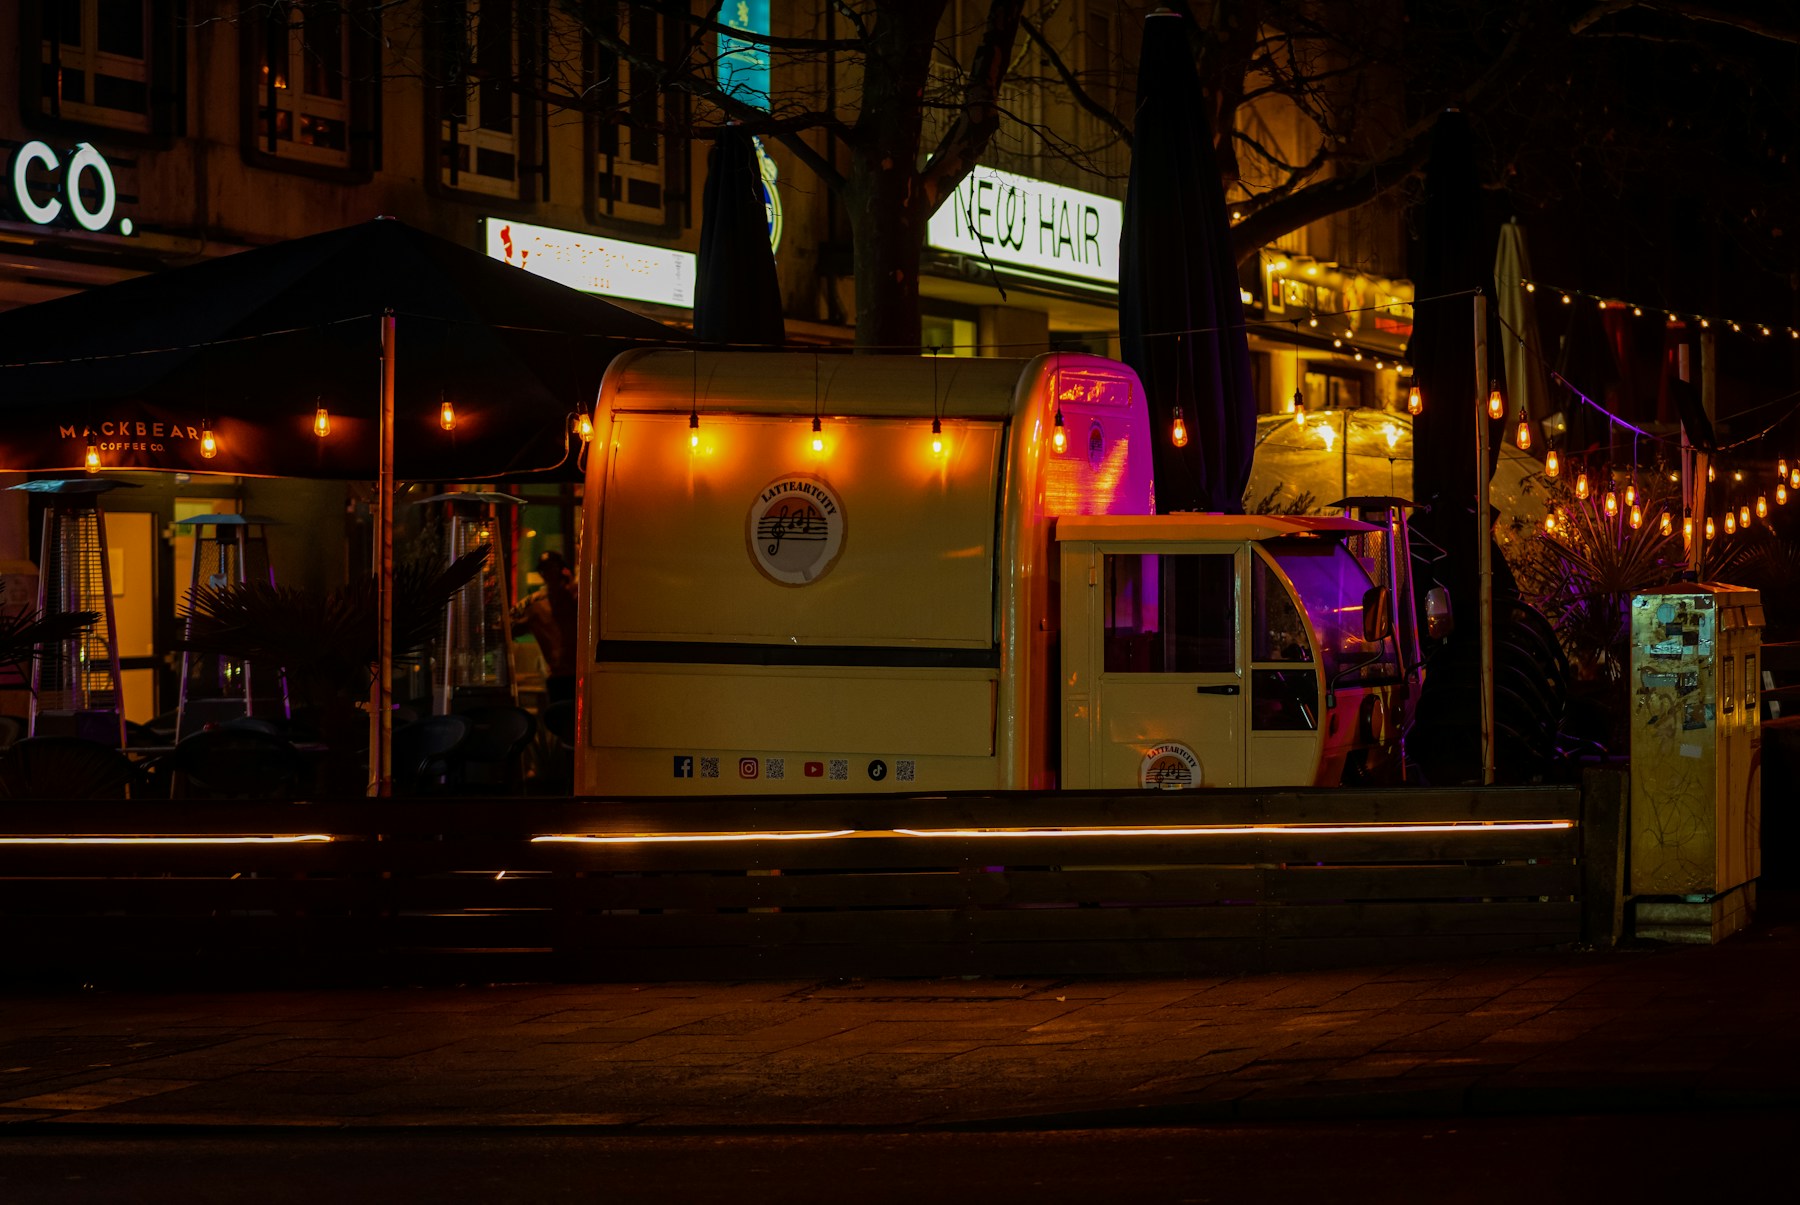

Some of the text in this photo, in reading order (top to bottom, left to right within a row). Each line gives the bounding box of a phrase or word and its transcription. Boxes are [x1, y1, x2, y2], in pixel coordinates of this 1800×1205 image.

[14, 141, 133, 236] CO.
[954, 174, 1102, 268] NEW HAIR
[59, 421, 200, 440] MACKBEAR
[100, 442, 166, 452] COFFEE CO.
[761, 481, 837, 515] LATTEARTCITY
[1147, 745, 1197, 768] LATTEARTCITY
